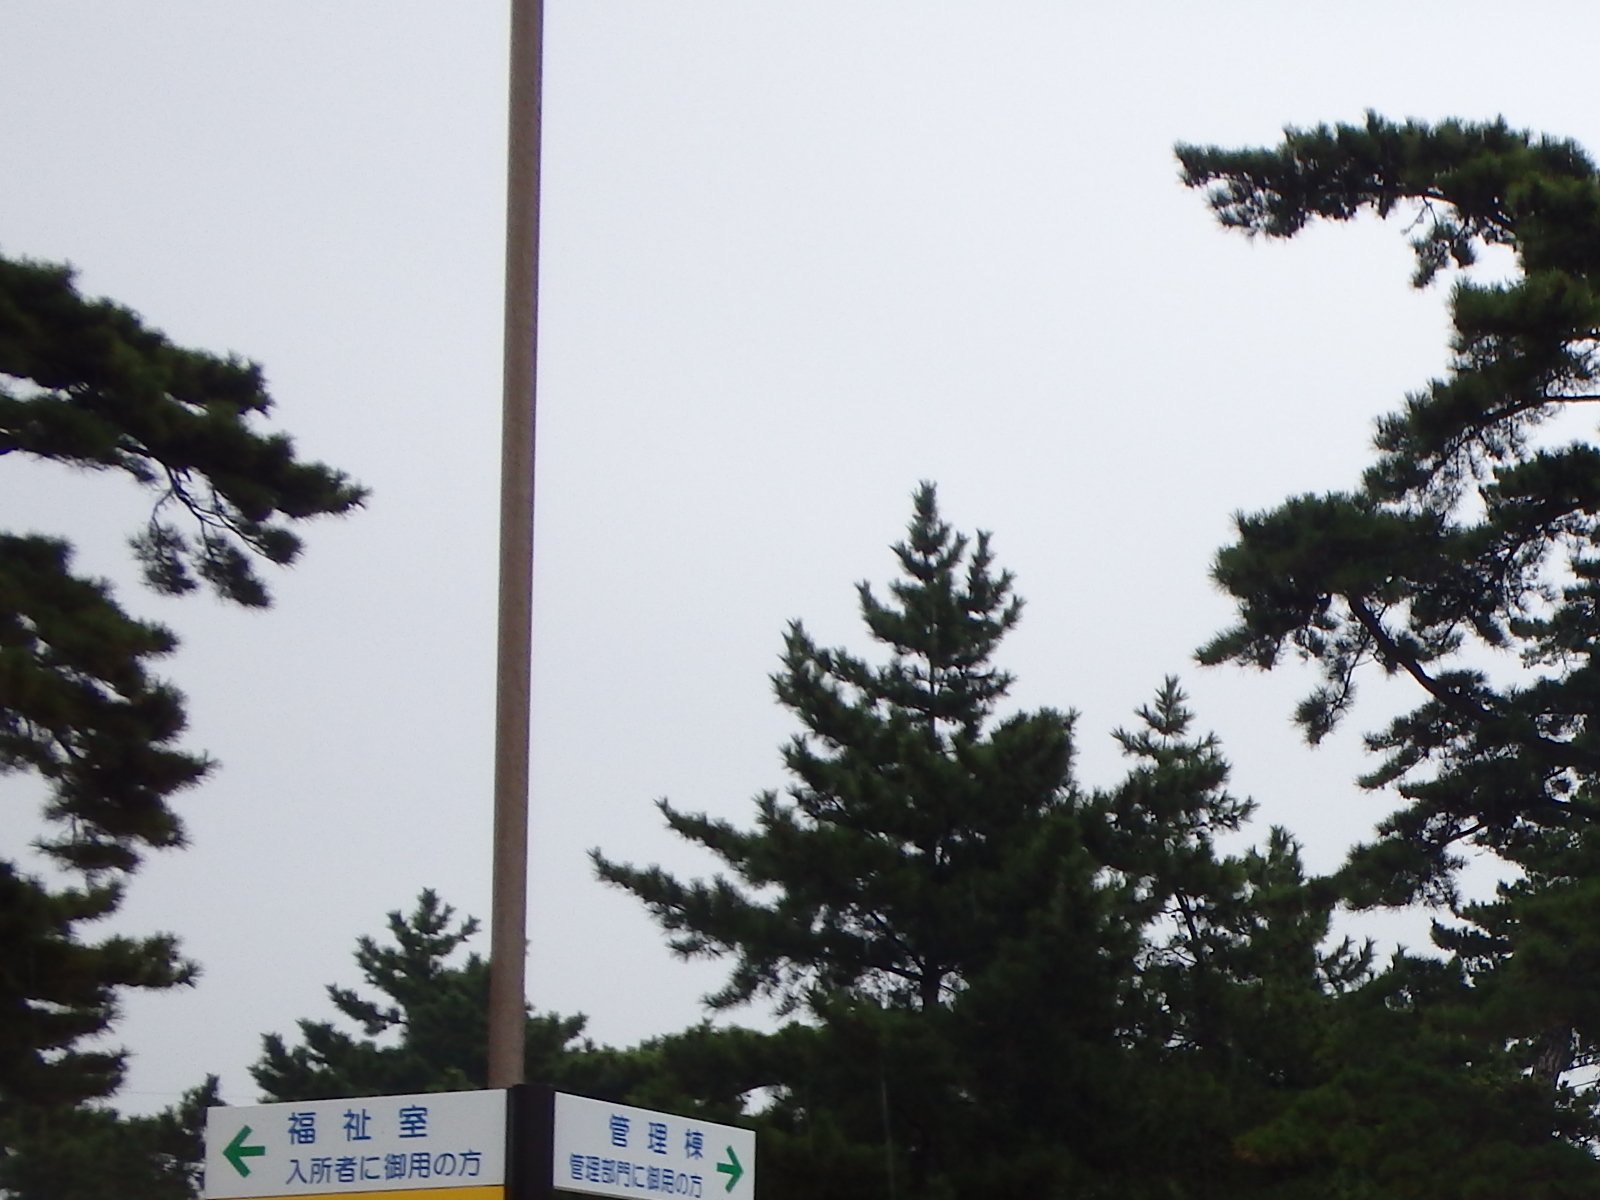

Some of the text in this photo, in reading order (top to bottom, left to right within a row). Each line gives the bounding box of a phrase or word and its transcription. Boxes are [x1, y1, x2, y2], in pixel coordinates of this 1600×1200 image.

[287, 1104, 428, 1145] 福祉室
[609, 1113, 705, 1160] 管理棟
[286, 1149, 482, 1185] 入所者に御用の方
[570, 1153, 703, 1199] 管理部門に御用の方
